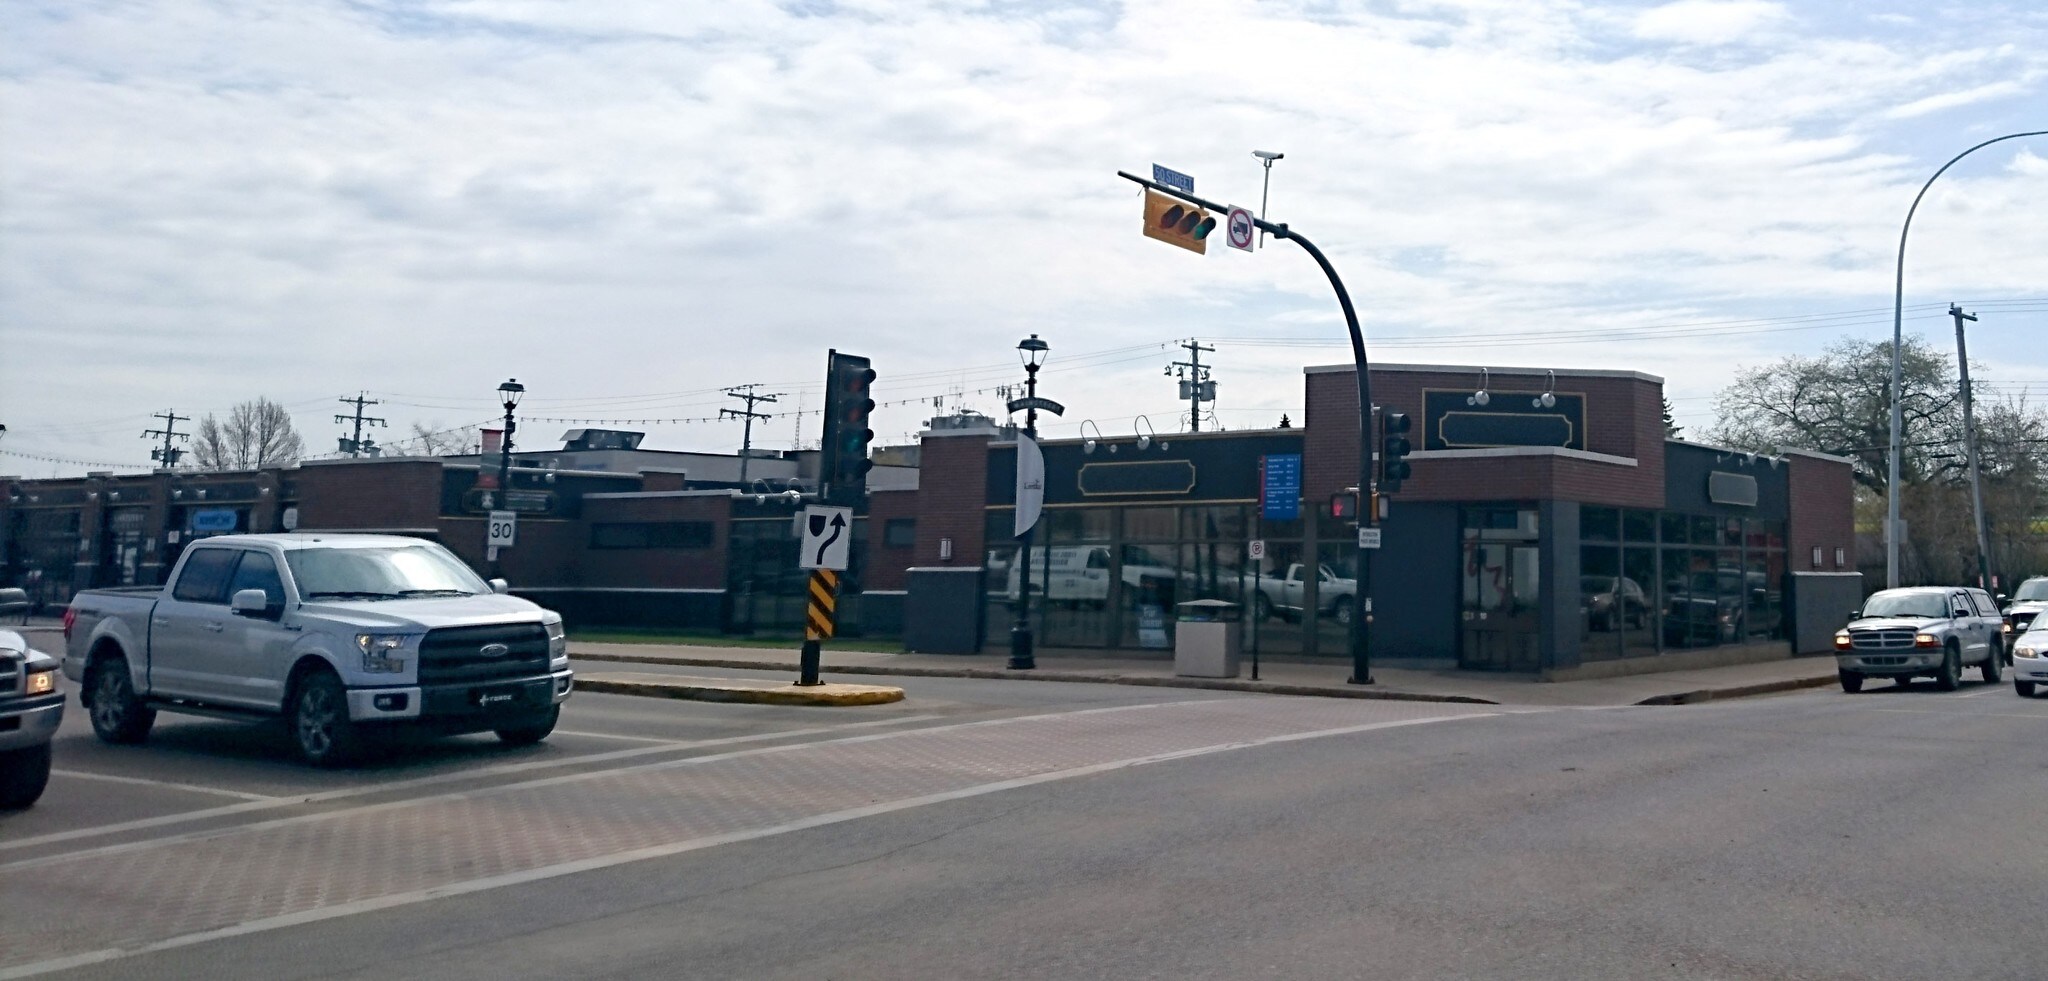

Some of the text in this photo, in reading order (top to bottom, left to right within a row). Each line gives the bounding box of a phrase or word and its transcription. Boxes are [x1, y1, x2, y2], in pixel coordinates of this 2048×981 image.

[1155, 167, 1192, 189] 50 STREET
[492, 523, 511, 538] 30
